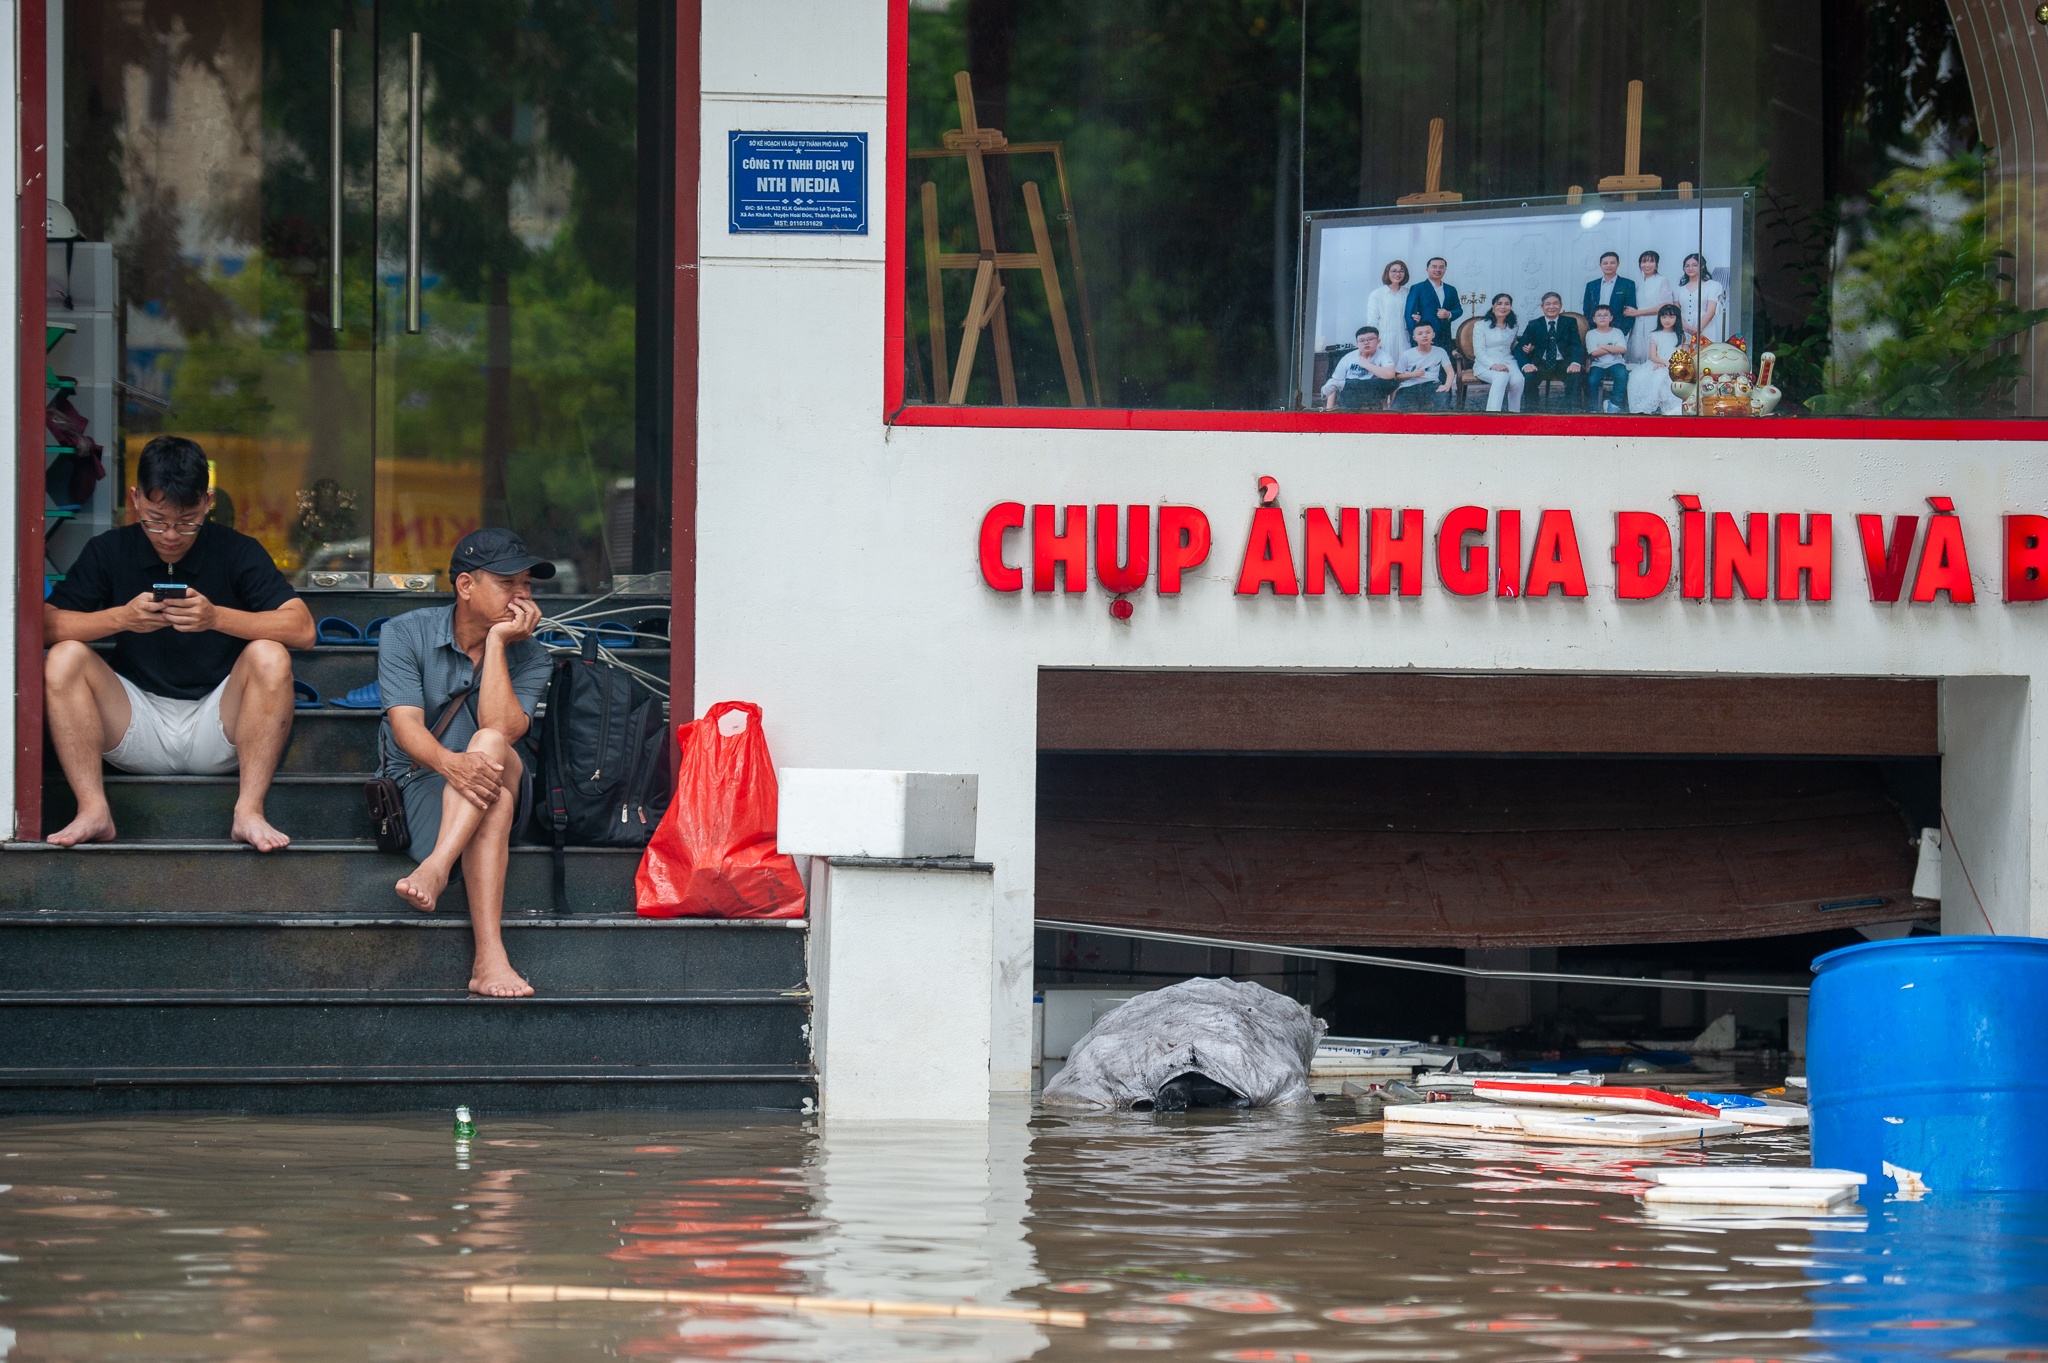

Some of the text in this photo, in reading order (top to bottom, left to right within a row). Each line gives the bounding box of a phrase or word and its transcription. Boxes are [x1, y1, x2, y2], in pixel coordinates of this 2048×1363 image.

[764, 140, 780, 148] HOẠCH
[781, 139, 787, 147] VÀ
[833, 140, 839, 148] HÀ
[742, 157, 855, 173] CÔNG TY TNHH DỊCH VỤ
[757, 177, 840, 193] NTH MEDIA
[978, 501, 1212, 620] CHỤP
[1234, 475, 1425, 597] ẢNH
[1436, 505, 1589, 599] GIA
[1610, 494, 1833, 602] ĐÌNH
[1855, 496, 1976, 604] VÀ
